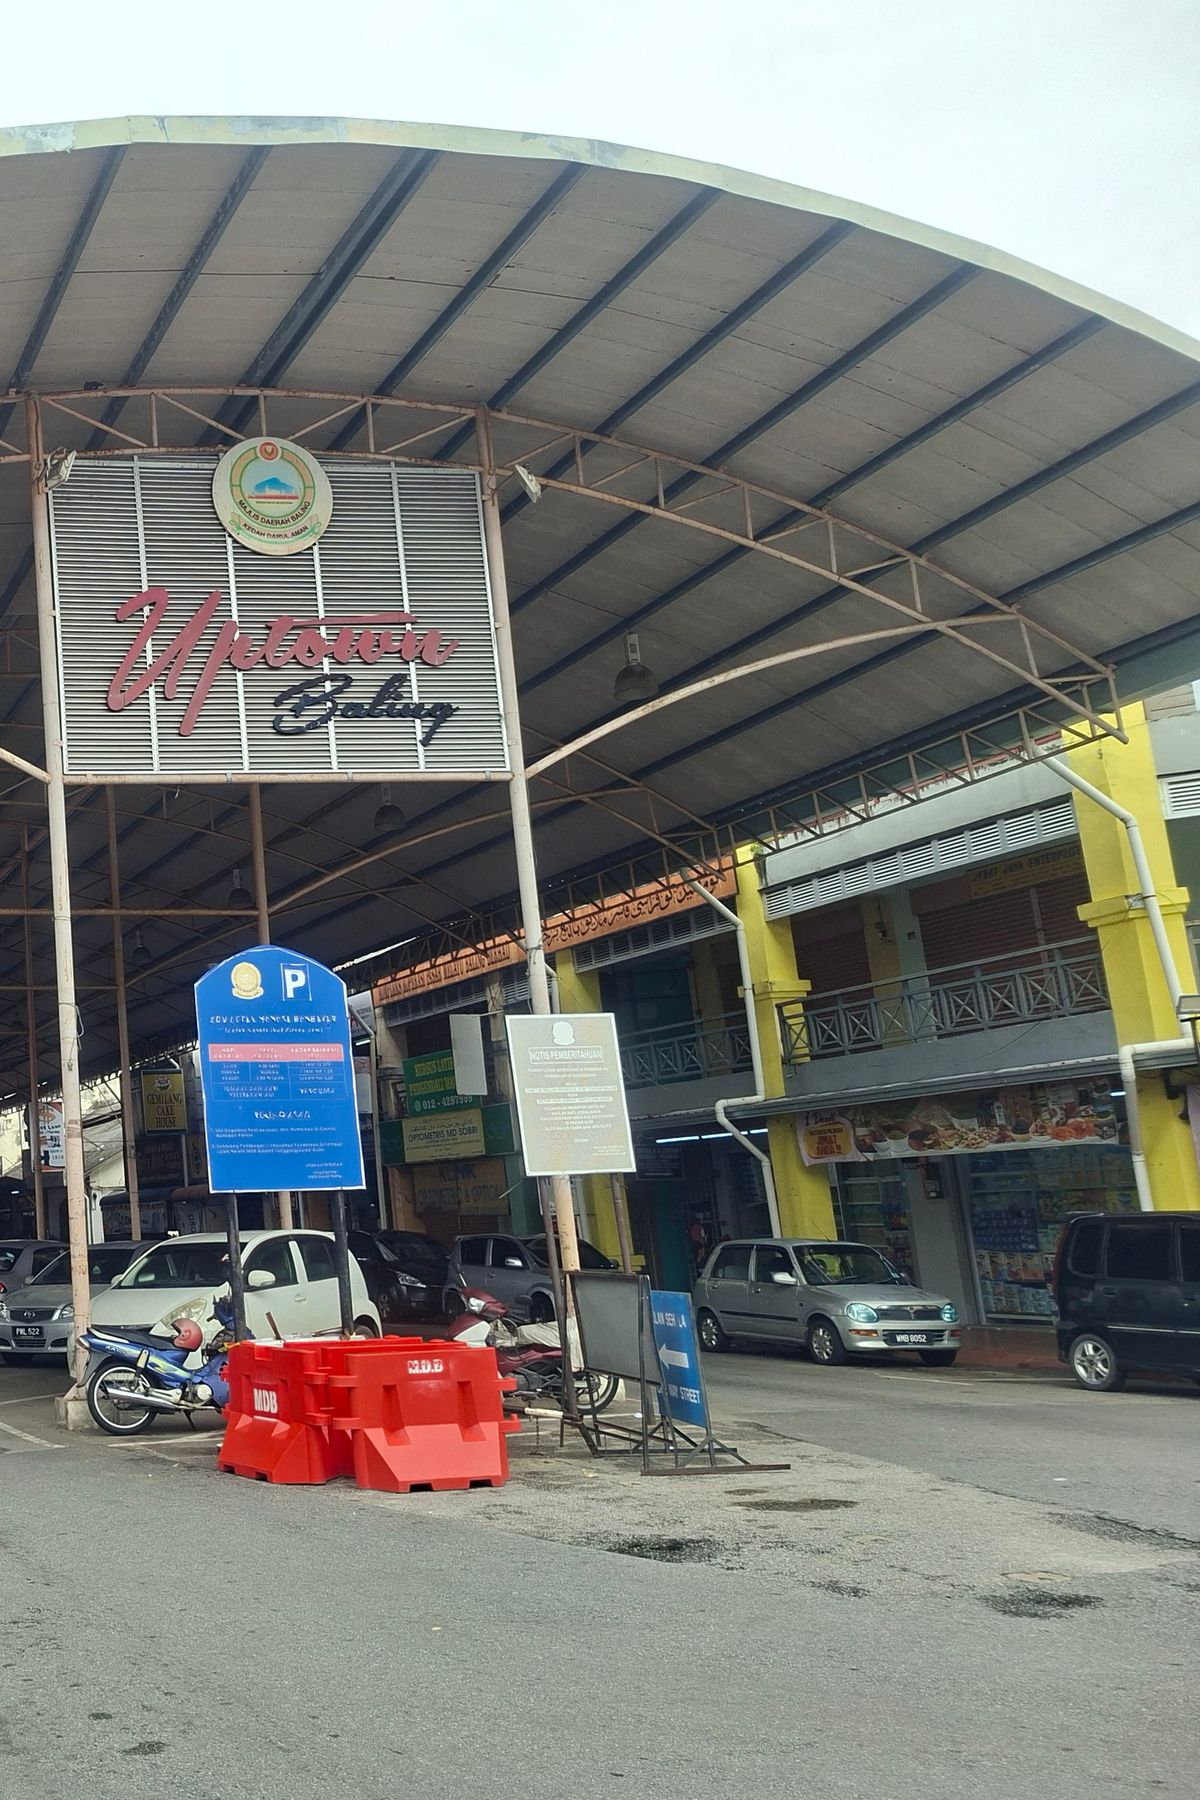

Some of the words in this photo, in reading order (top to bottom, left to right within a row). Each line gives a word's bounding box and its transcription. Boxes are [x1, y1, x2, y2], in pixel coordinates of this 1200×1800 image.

[238, 500, 260, 521] MAJLIS
[260, 516, 291, 526] DAERAH
[291, 500, 310, 523] BALING
[242, 522, 266, 537] KEDAH
[107, 588, 459, 736] Uptown
[273, 672, 460, 748] Baling
[284, 968, 305, 999] P
[530, 1051, 550, 1060] NOTIS
[550, 1050, 602, 1060] PEMBERITAHUAN
[146, 1093, 182, 1105] GEMILANG
[156, 1105, 174, 1116] CAKE
[156, 1117, 176, 1128] HOUSE
[408, 1130, 444, 1142] OPTOMETRIS
[459, 1126, 477, 1135] SOBRI
[28, 1327, 40, 1336] 522
[896, 1334, 909, 1342] WMB
[910, 1334, 926, 1342] 8052
[253, 1388, 278, 1414] MDB
[680, 1386, 700, 1404] STREET
